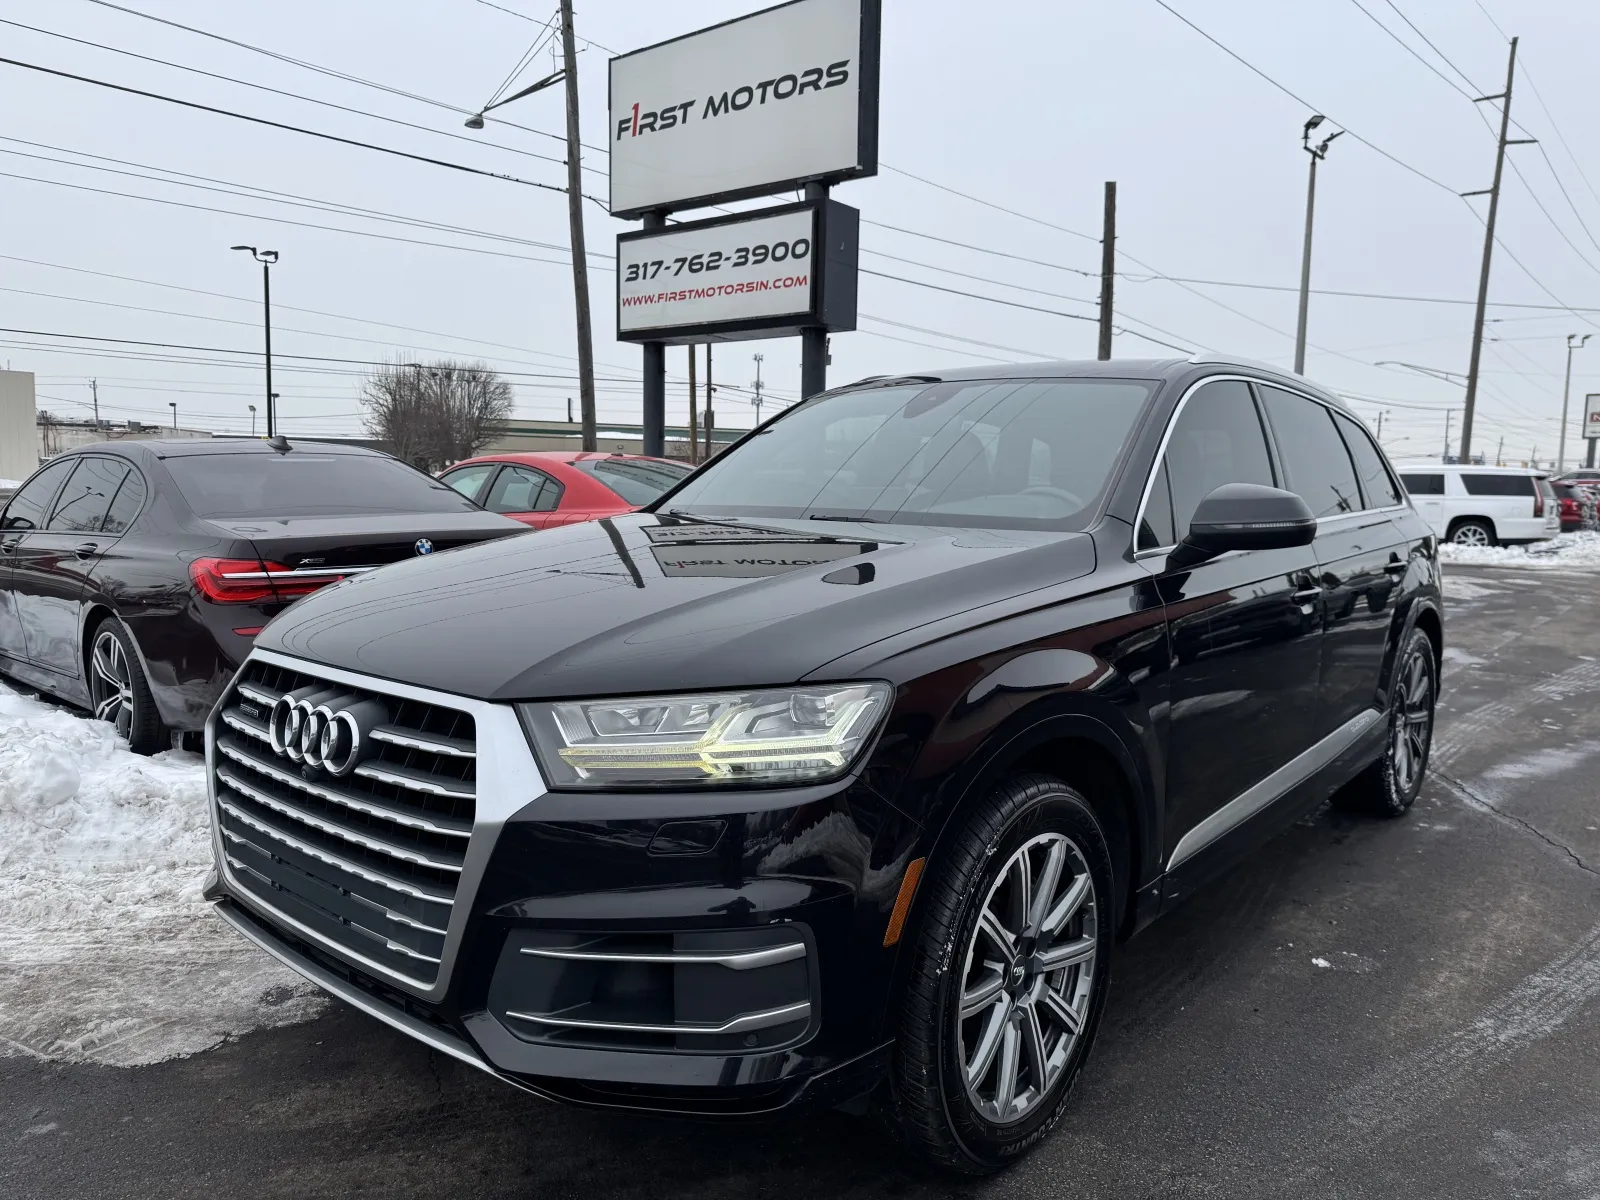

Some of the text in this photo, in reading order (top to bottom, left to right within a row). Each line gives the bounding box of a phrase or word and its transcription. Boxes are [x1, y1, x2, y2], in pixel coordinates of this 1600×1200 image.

[702, 59, 850, 119] MOTORS
[625, 238, 810, 282] 317-762-3900
[622, 275, 808, 307] WWW.FIRSTMOTORSIN.COM
